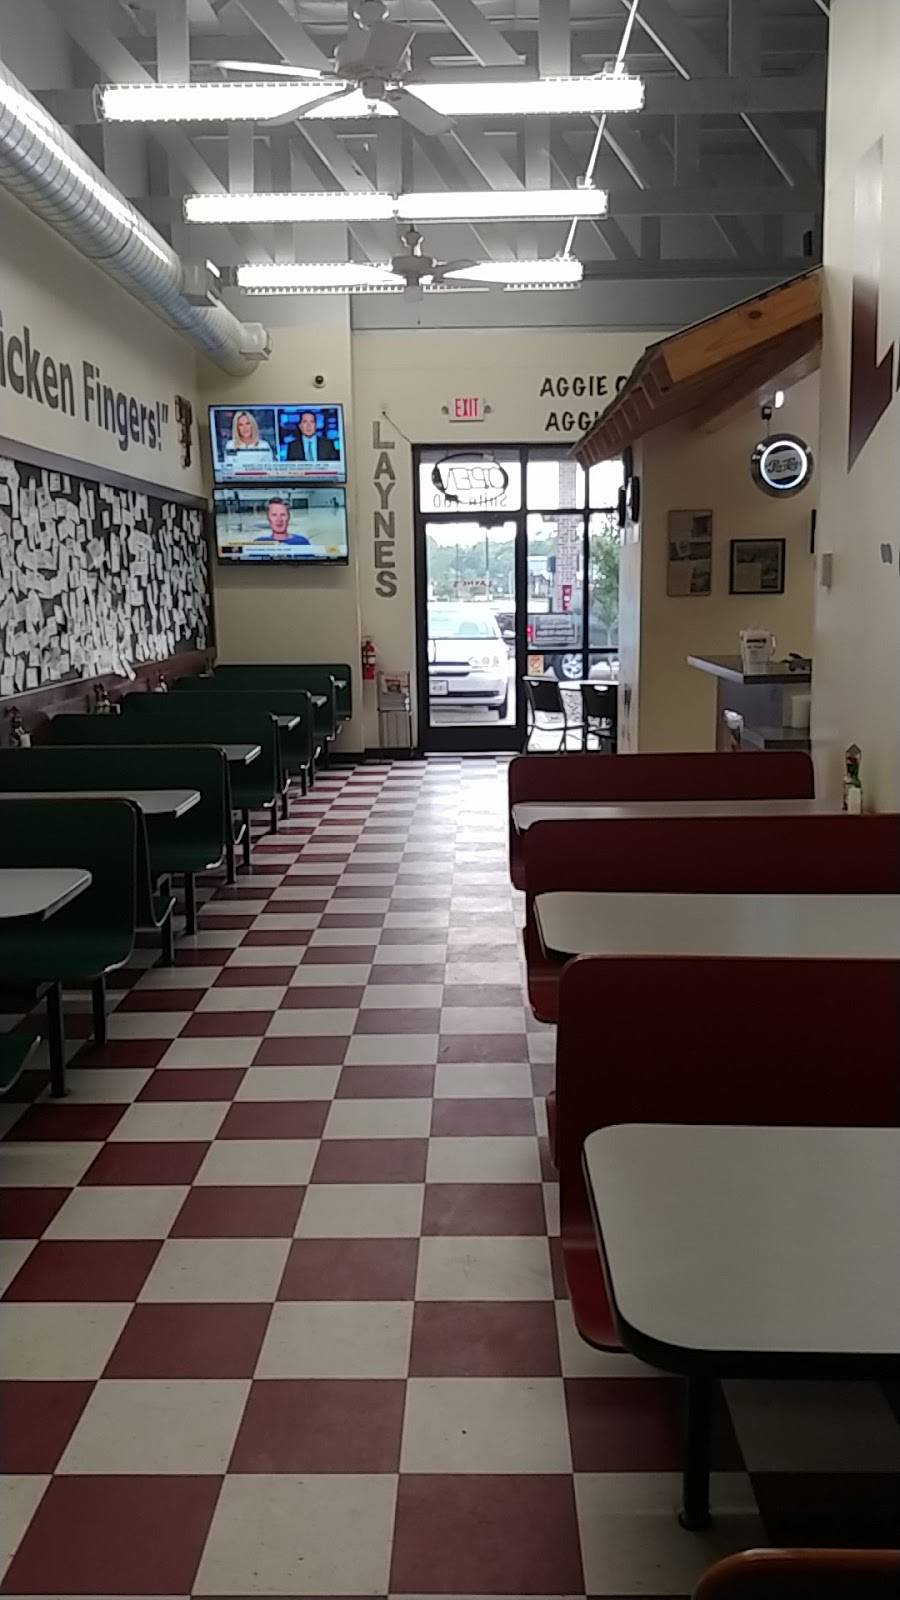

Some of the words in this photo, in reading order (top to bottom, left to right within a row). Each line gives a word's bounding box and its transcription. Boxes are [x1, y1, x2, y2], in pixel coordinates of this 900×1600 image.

[83, 360, 169, 452] Fingers!"
[455, 397, 479, 417] EXIT
[539, 375, 608, 397] AGGIE
[372, 421, 398, 599] LAYNES
